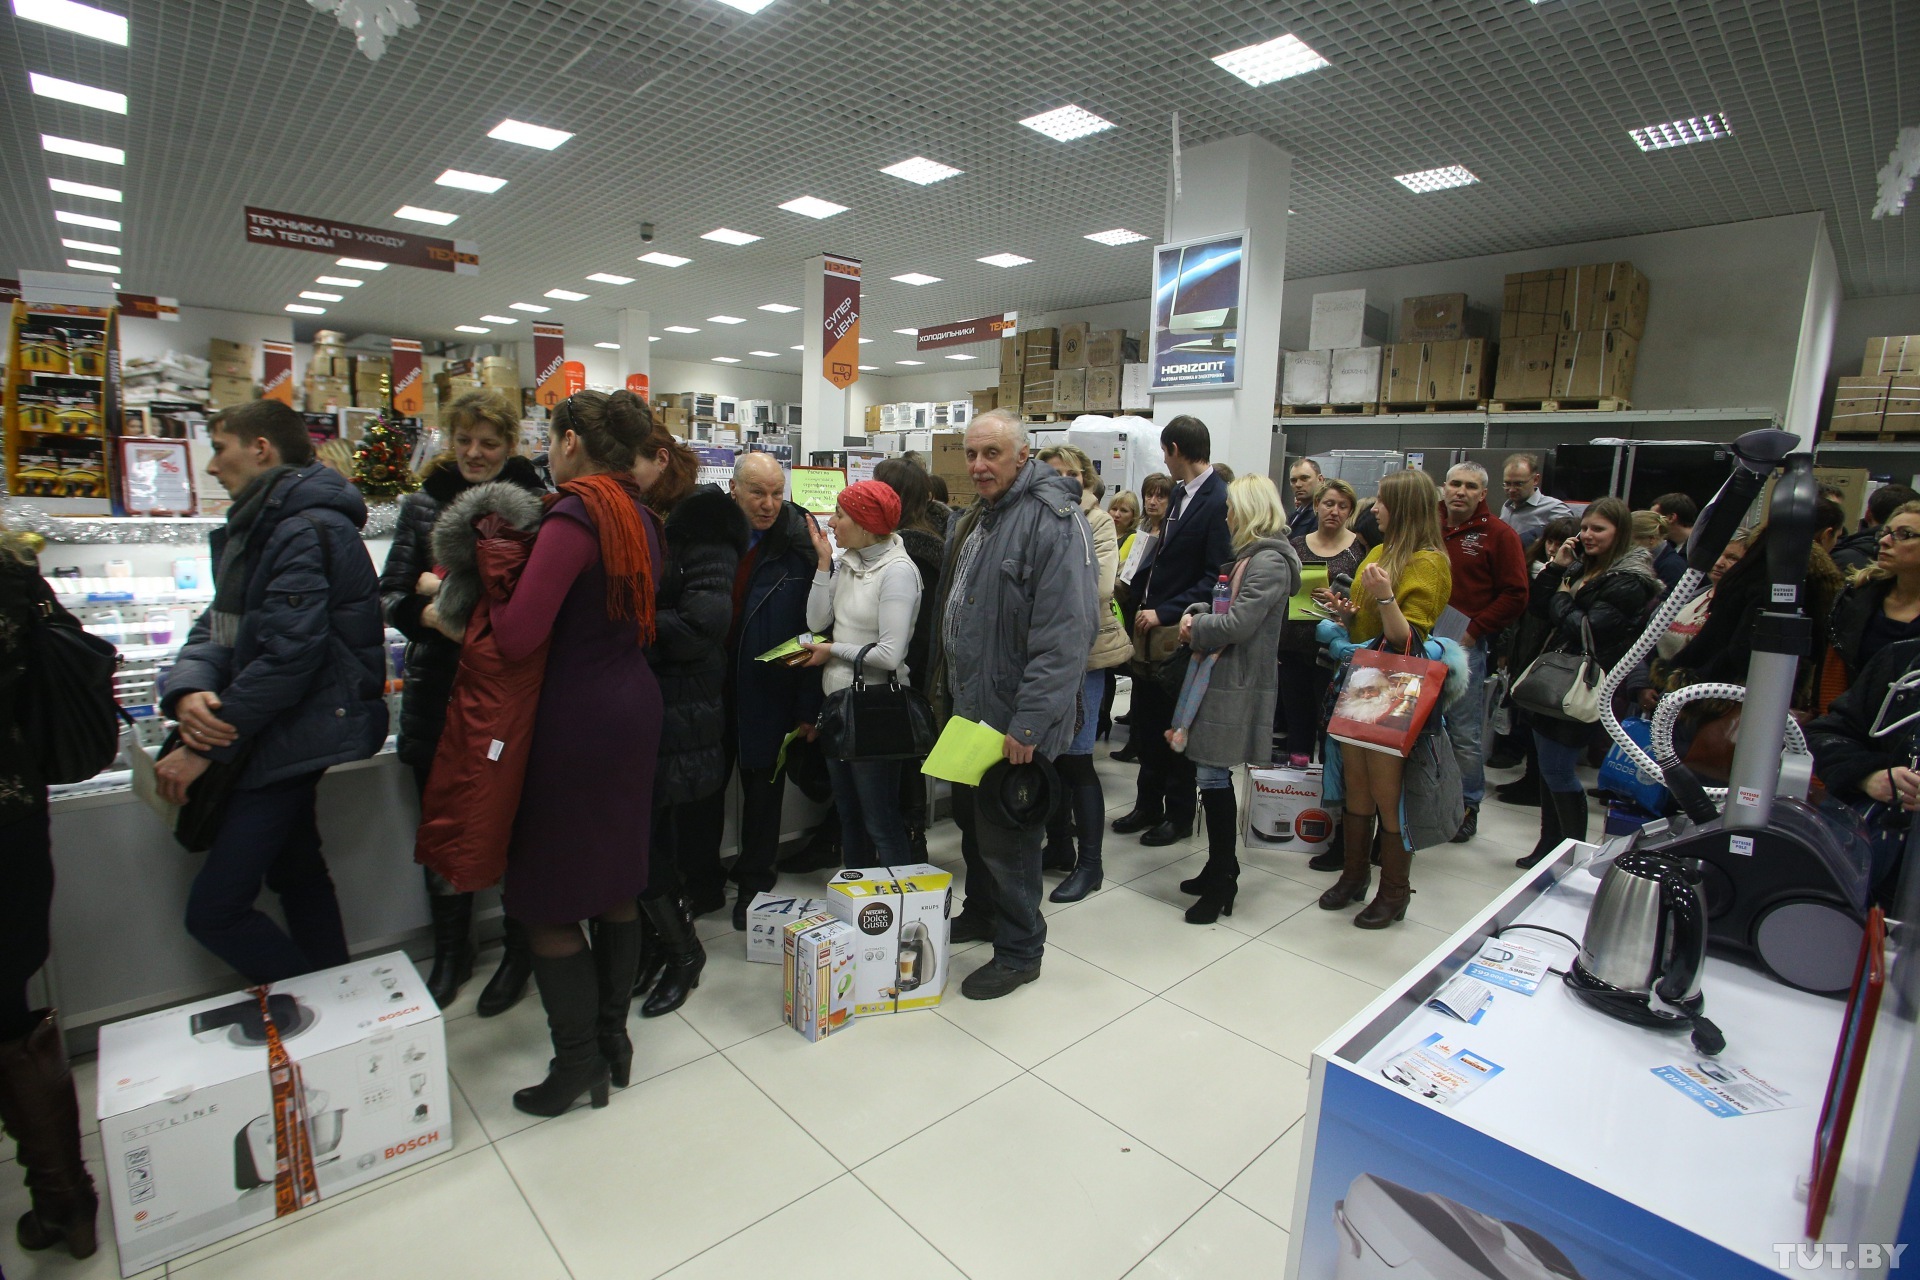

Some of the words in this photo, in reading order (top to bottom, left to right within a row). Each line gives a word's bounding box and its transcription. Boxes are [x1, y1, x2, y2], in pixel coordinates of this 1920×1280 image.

[248, 213, 328, 236] ТЕХНИКА
[331, 228, 353, 239] ПО
[355, 231, 407, 248] УХОДУ
[249, 226, 275, 239] ЗА
[278, 230, 336, 248] ТЕЛОМ
[824, 297, 852, 331] СУПЕР
[833, 311, 859, 340] ЦЕНА
[919, 327, 975, 342] ХОЛОДИЛЬНИКИ
[536, 355, 564, 387] АКЦИЯ
[1161, 361, 1226, 375] HORIZONT
[394, 366, 422, 394] АКЦИЯ
[1254, 780, 1319, 797] Moulinex
[863, 914, 889, 923] Dolce
[863, 920, 888, 929] Gusto
[378, 1006, 420, 1022] BOSCH
[1431, 1070, 1459, 1087] -50%
[127, 1104, 219, 1140] STYLINE
[384, 1130, 439, 1160] BOSCH
